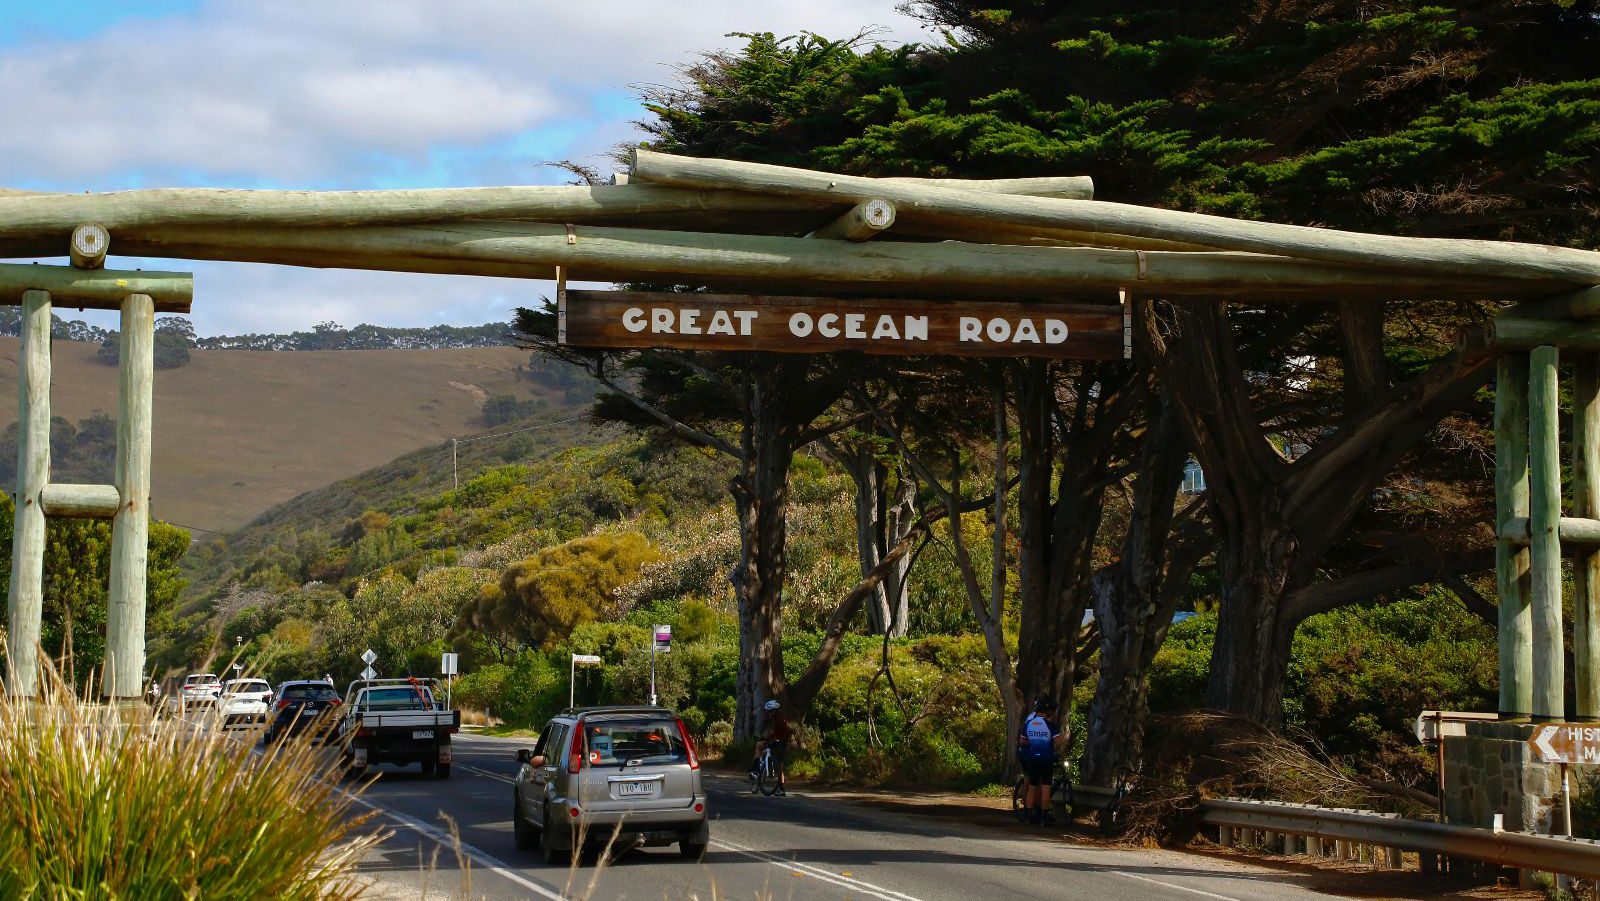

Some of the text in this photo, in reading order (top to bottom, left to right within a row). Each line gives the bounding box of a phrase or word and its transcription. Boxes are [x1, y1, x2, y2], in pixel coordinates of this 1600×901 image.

[622, 307, 1068, 344] GREAT OCEAN ROAD
